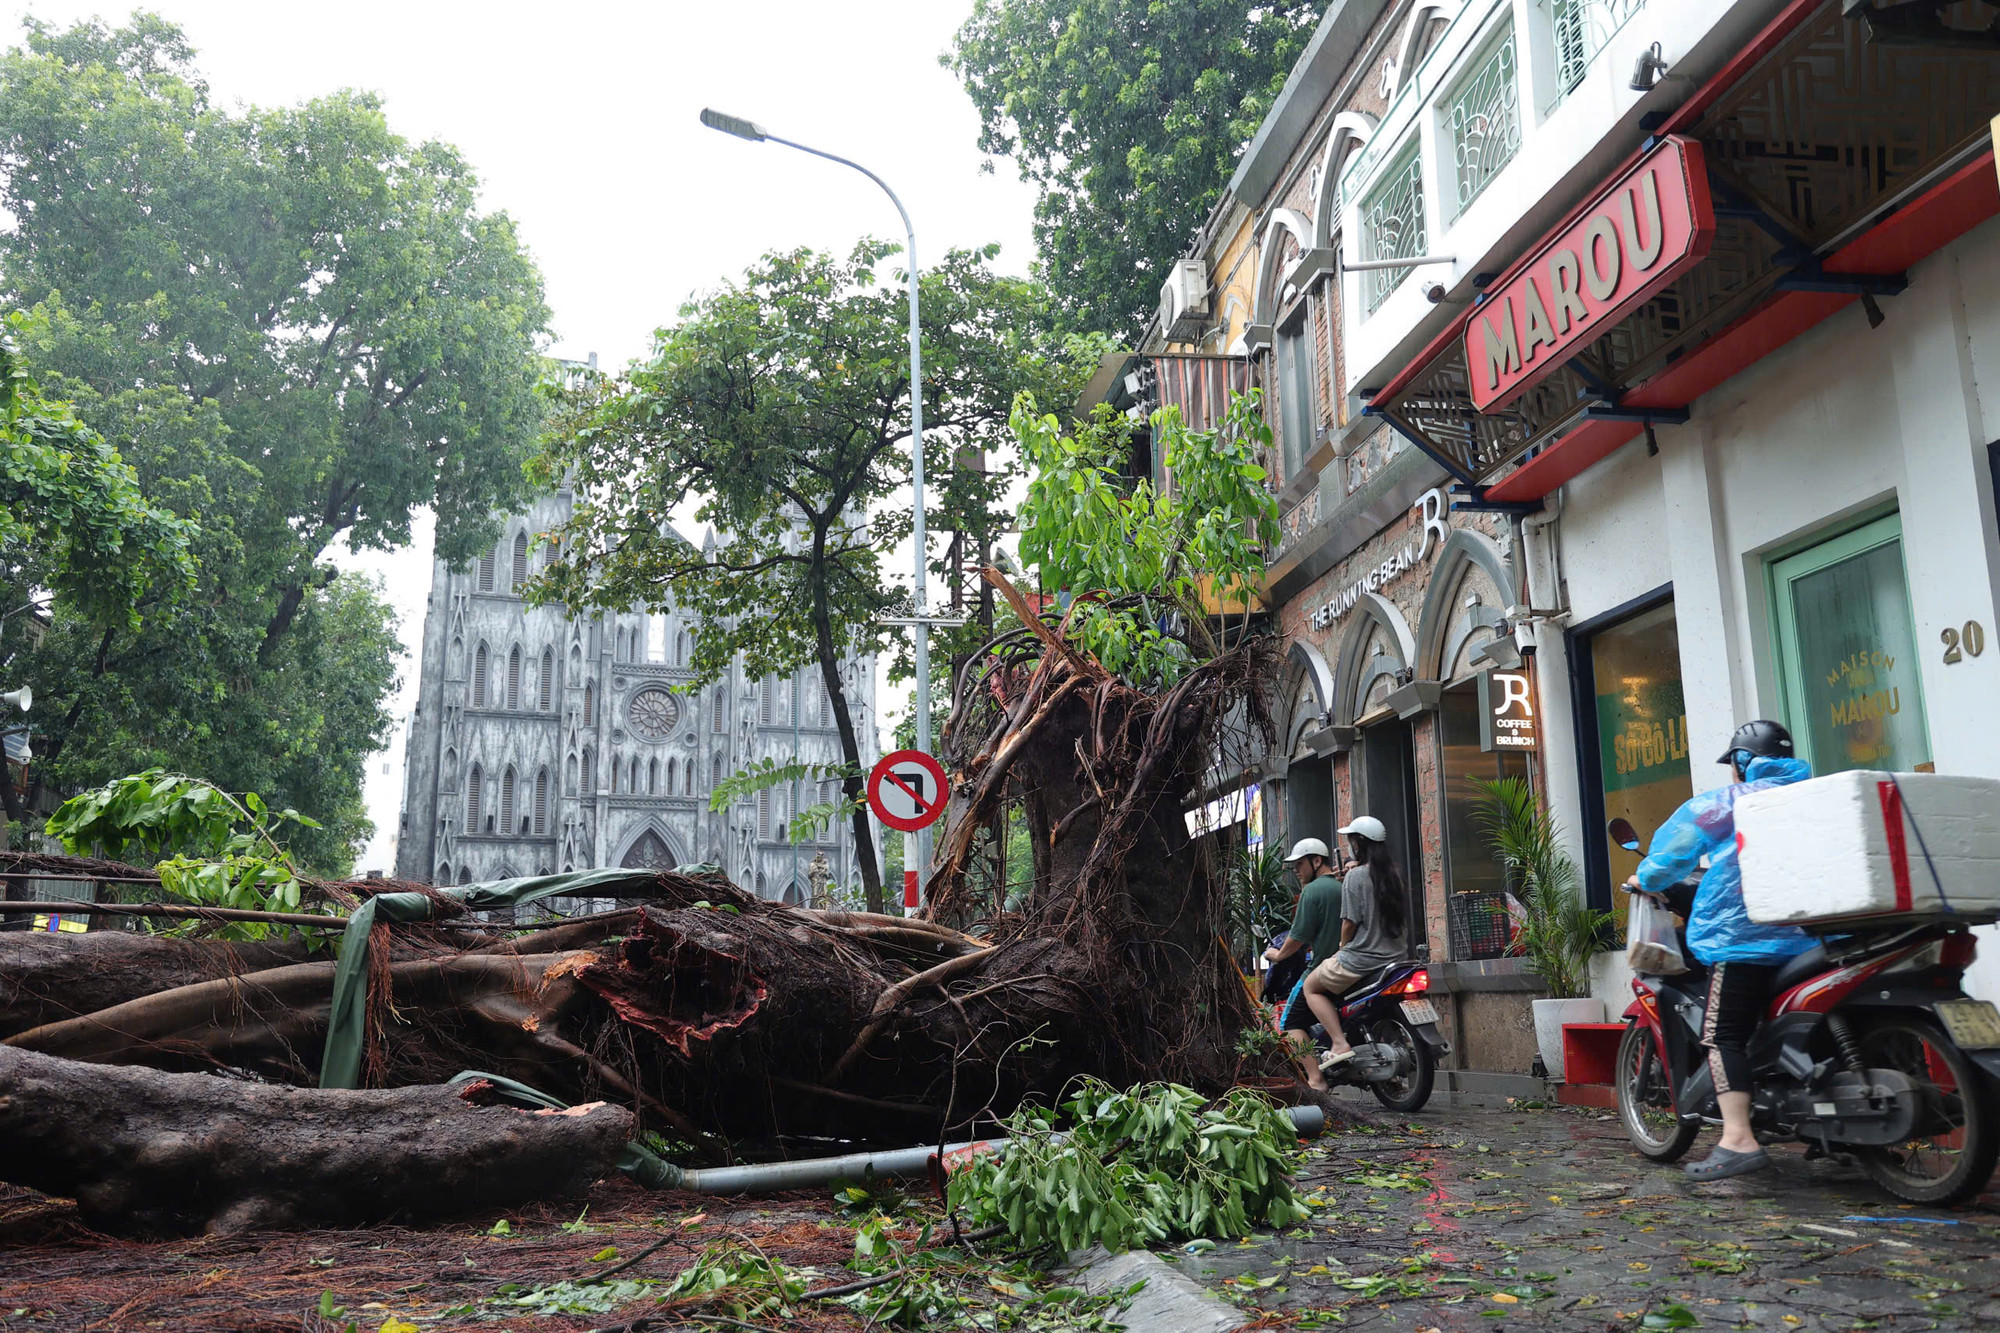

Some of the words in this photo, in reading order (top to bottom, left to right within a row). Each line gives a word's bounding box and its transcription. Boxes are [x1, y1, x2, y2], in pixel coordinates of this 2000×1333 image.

[1482, 169, 1663, 390] MAROU
[1310, 603, 1330, 632] THE
[1329, 569, 1379, 621] RUNNING
[1380, 543, 1415, 585] BEAN
[1940, 619, 1984, 665] 20
[1826, 651, 1895, 688] MAISON
[1496, 719, 1533, 729] COFFEE
[1830, 686, 1900, 728] MAROU
[1496, 736, 1535, 746] BRUNCH
